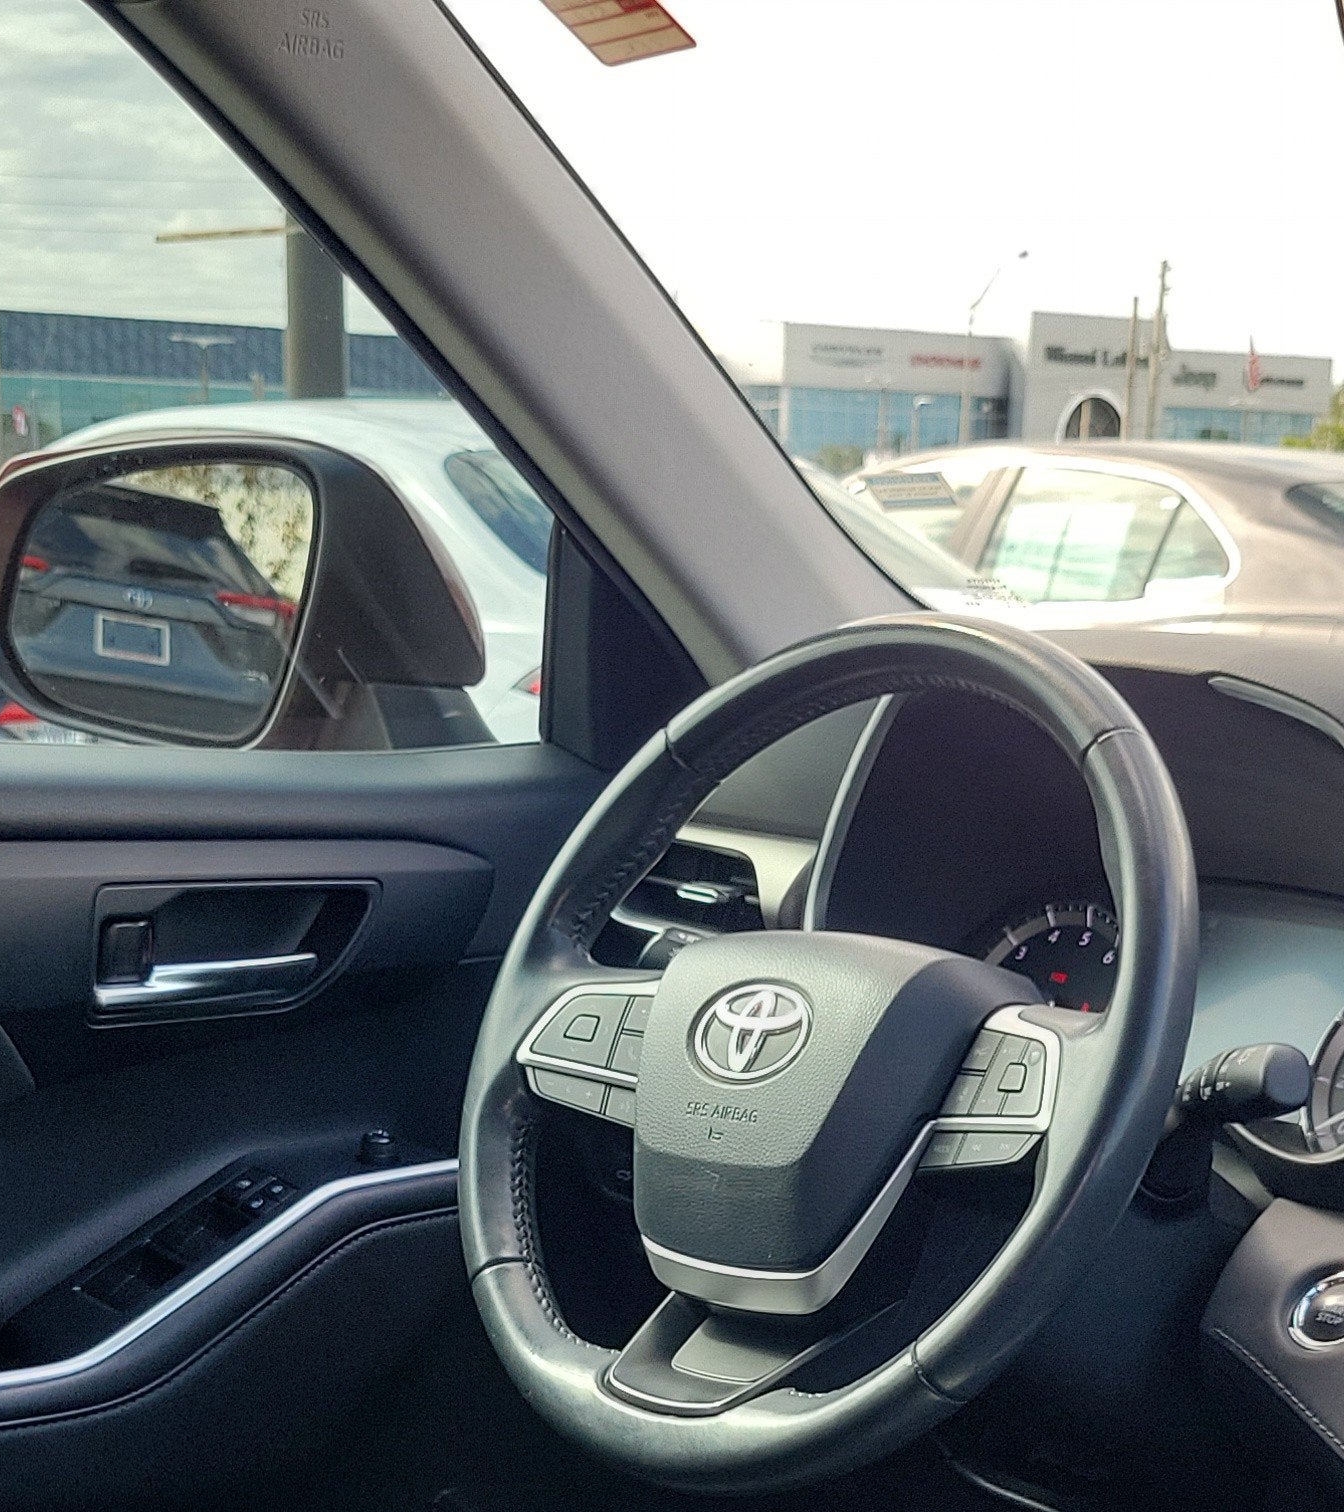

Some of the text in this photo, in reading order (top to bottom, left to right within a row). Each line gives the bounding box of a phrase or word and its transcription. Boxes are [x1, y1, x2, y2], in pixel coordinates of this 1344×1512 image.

[278, 31, 345, 60] AIRBAG
[1048, 929, 1061, 944] 4
[1078, 931, 1093, 946] 5
[1015, 945, 1029, 960] 3
[1102, 949, 1115, 965] 6
[710, 1104, 758, 1124] AIRBAG
